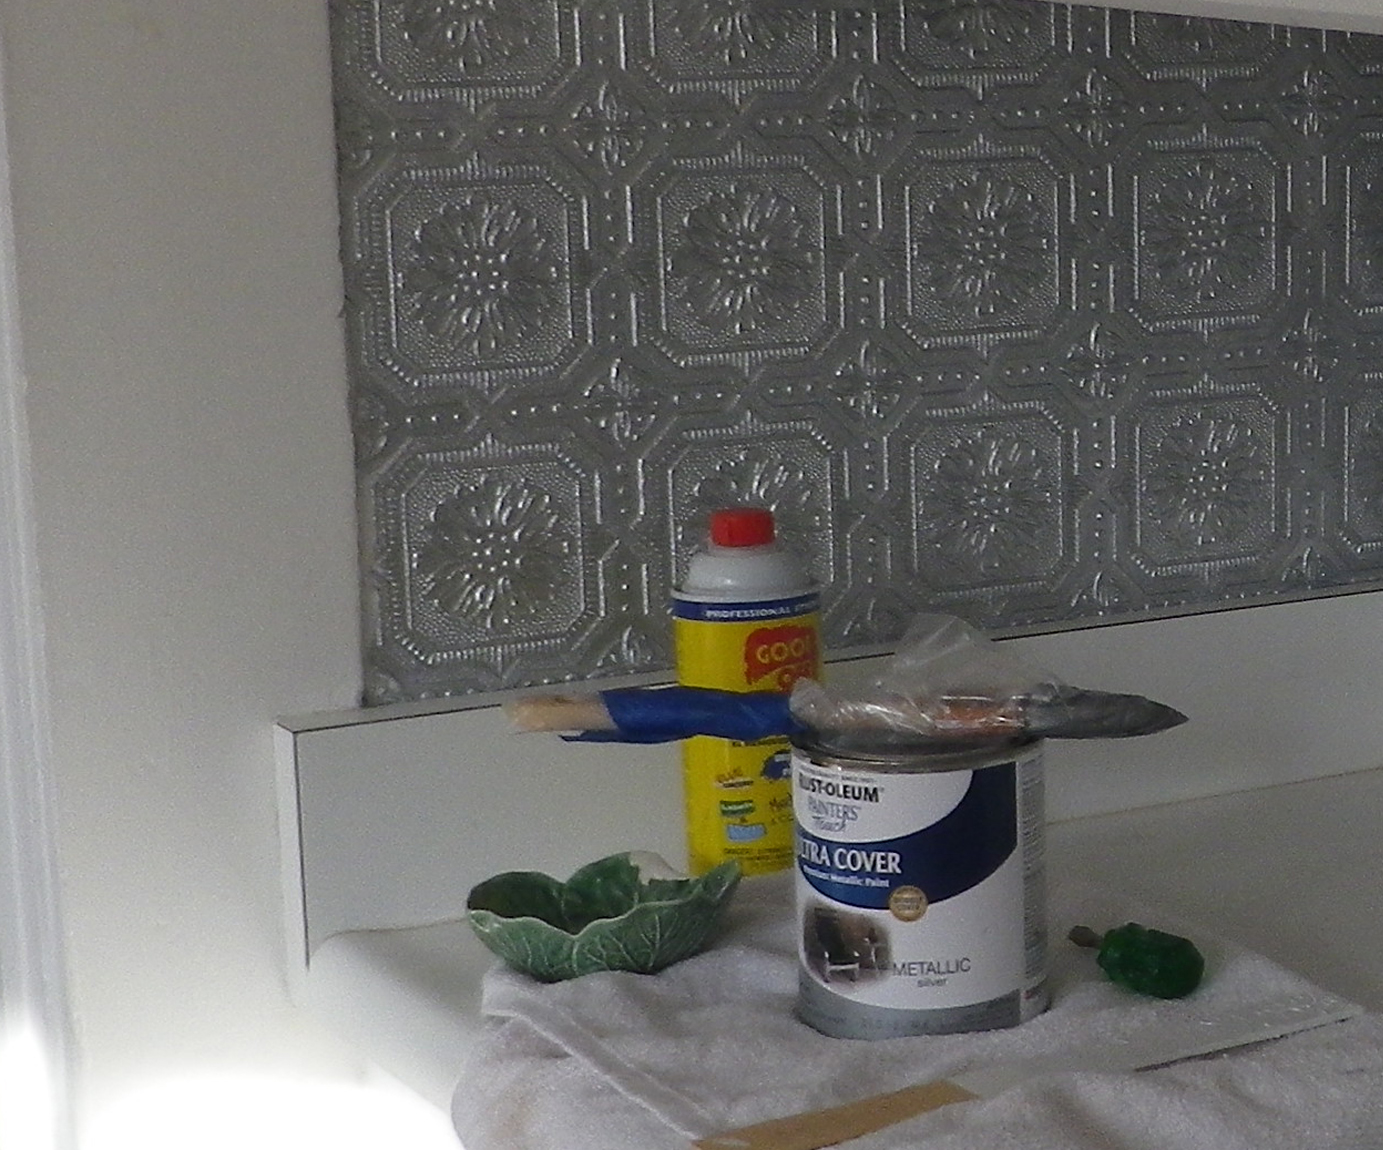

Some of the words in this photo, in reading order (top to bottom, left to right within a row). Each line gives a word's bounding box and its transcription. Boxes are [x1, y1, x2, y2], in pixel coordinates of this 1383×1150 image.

[705, 606, 791, 618] PROFESSIONAL
[798, 836, 831, 867] LTRA
[834, 847, 903, 875] COVER
[865, 877, 890, 888] Paint
[893, 957, 972, 977] METALLIC
[917, 977, 947, 988] silver
